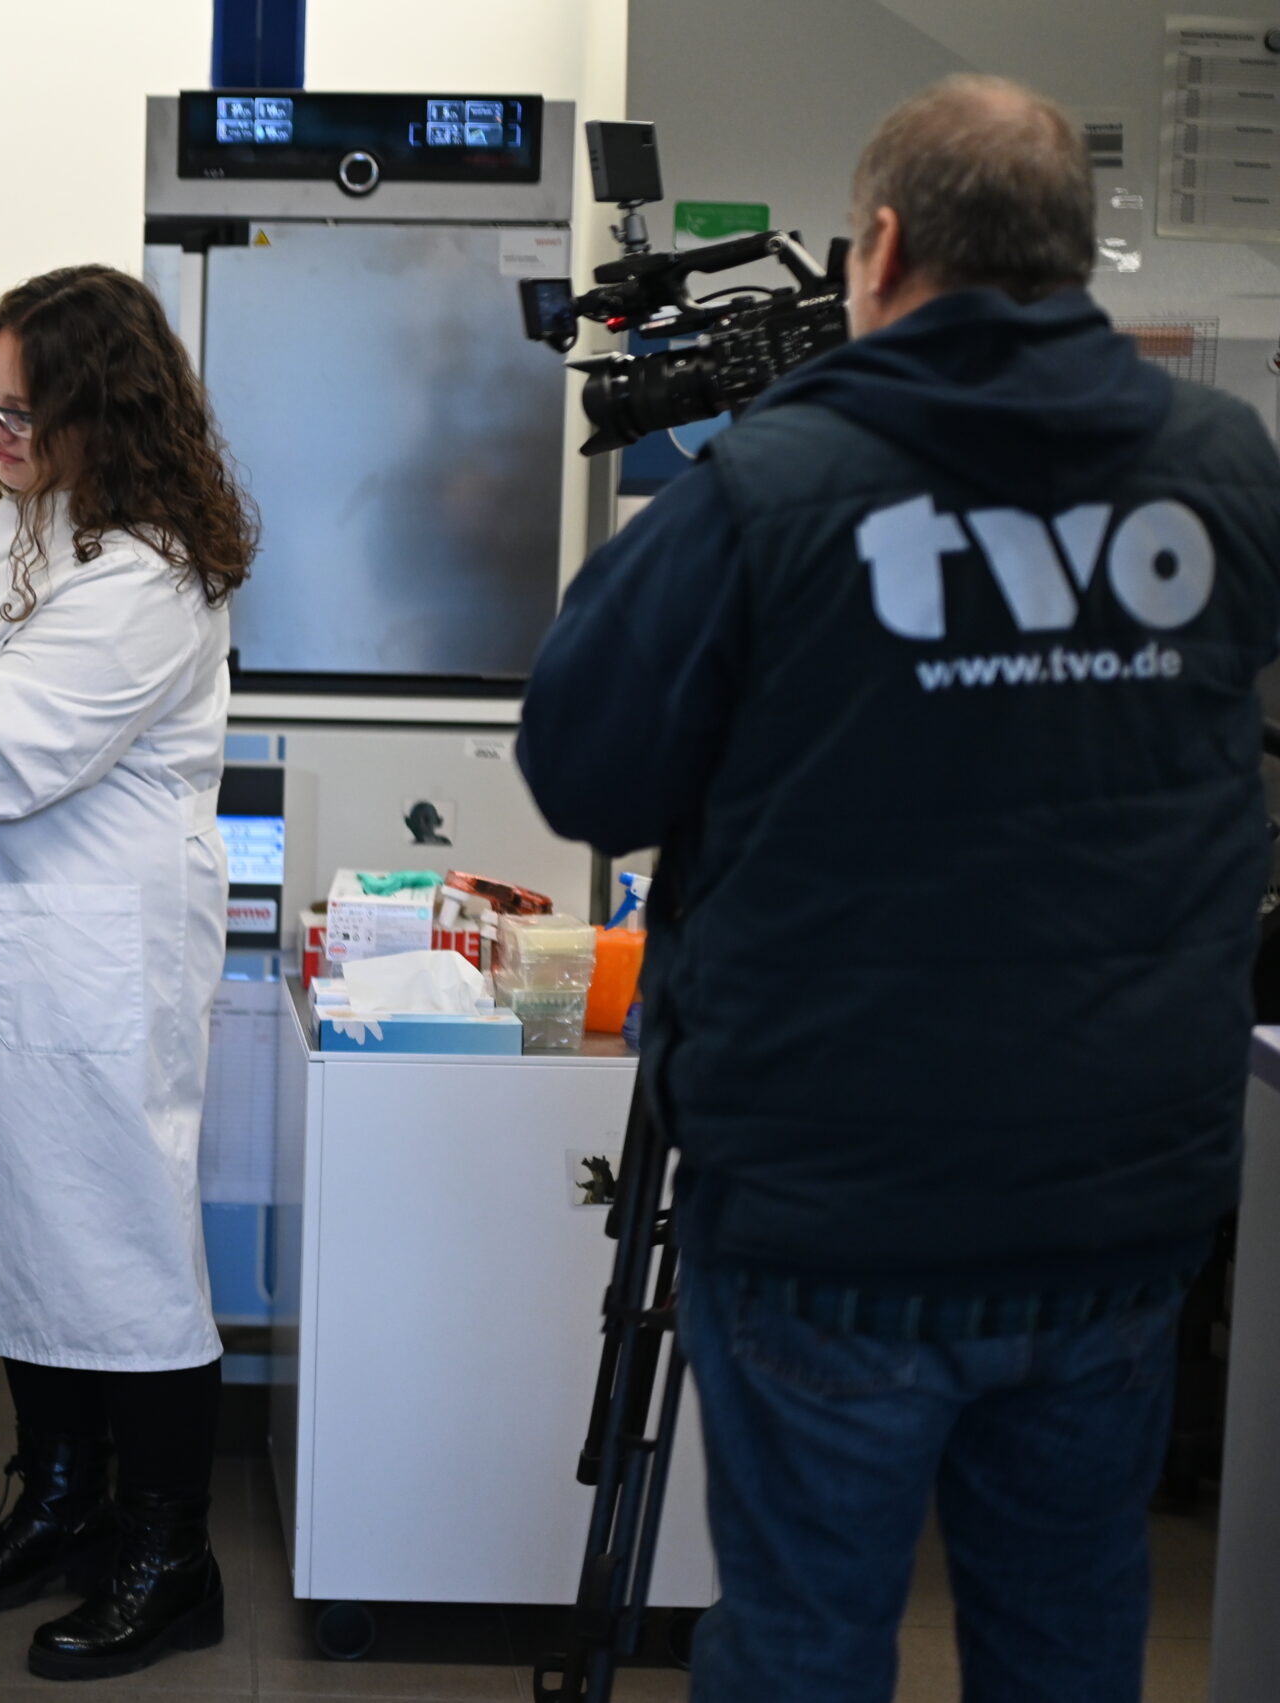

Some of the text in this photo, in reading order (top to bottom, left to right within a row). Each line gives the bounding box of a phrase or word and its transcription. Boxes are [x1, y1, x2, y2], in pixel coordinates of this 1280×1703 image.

[796, 292, 838, 308] SONY
[855, 494, 1215, 639] tvo
[916, 643, 1182, 690] www.tvo.de
